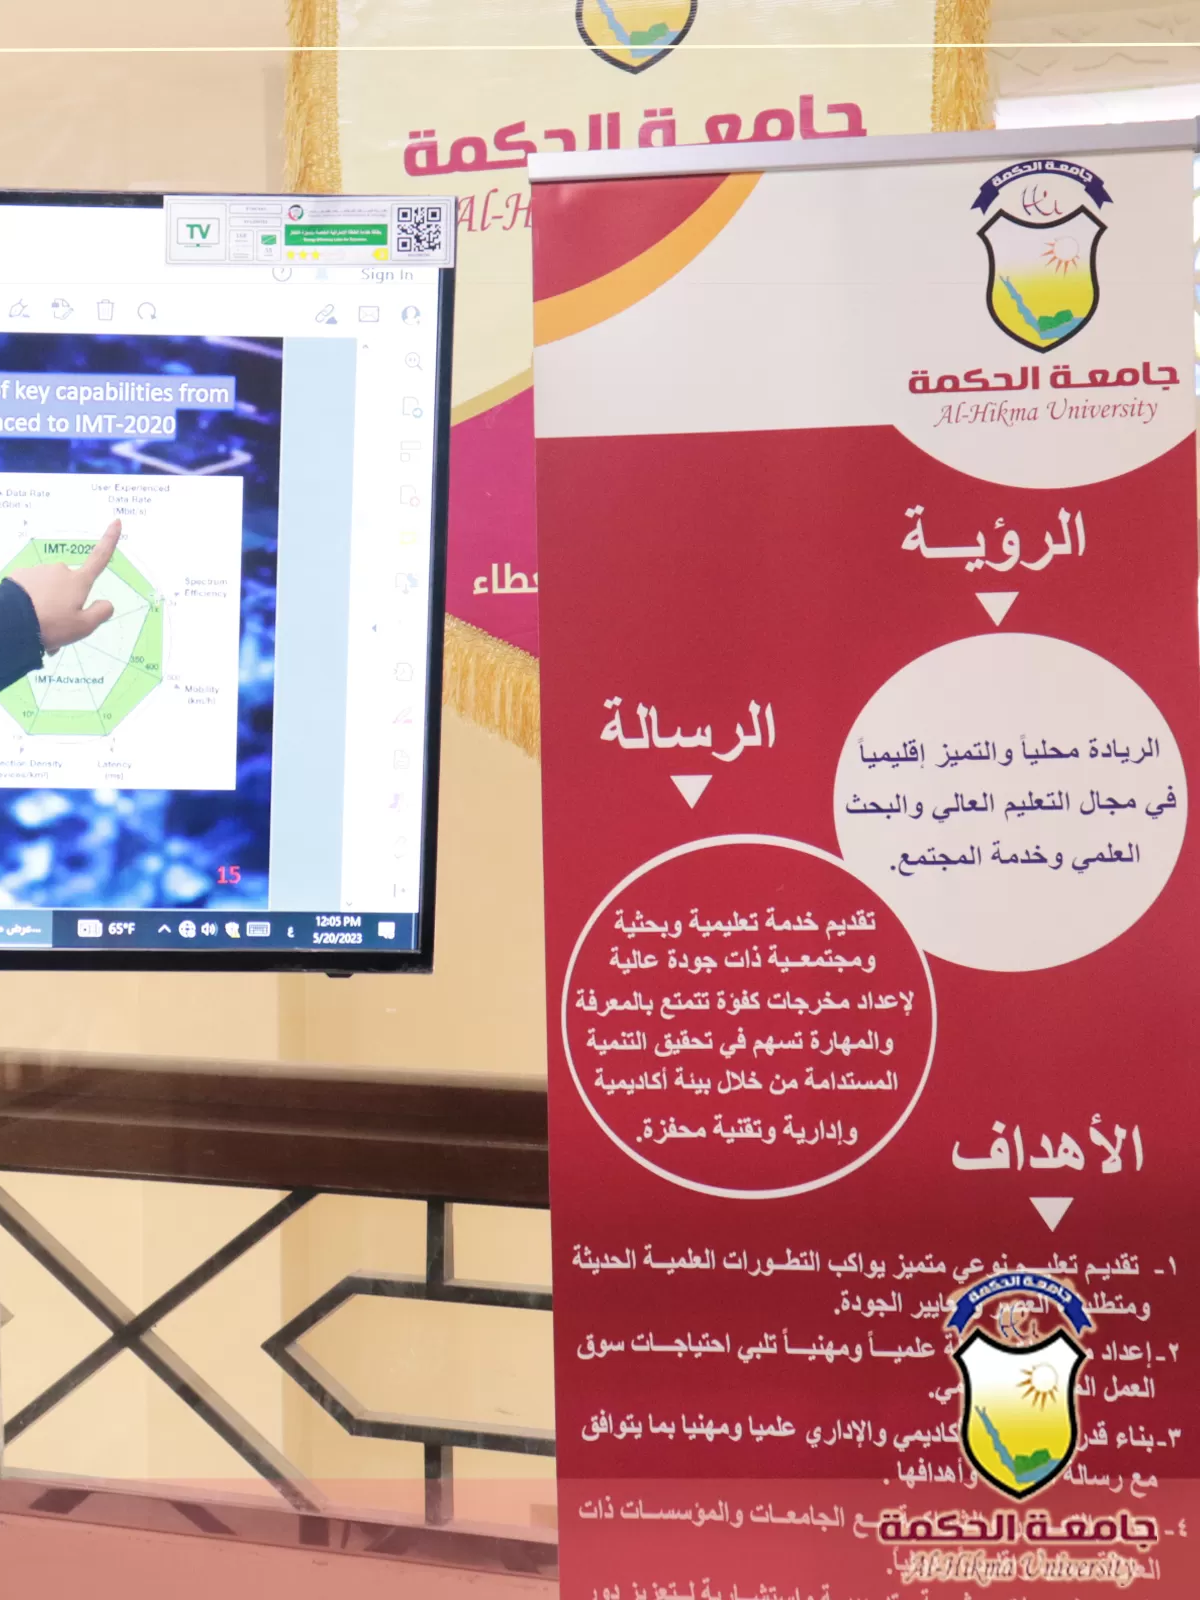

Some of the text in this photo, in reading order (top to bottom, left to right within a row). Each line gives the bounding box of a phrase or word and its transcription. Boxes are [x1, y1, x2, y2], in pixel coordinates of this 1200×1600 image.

[992, 162, 1042, 186] الحكمة
[186, 224, 211, 239] TV
[361, 268, 415, 283] Sign In
[908, 361, 1180, 394] جامعة الحكمة
[15, 380, 49, 405] key
[56, 381, 172, 406] capabilities
[178, 383, 229, 402] from
[47, 414, 69, 432] to
[76, 414, 175, 434] IMT-2020
[933, 400, 1158, 427] Al-Hikma University
[5, 488, 27, 498] Data
[29, 488, 51, 499] Rate
[107, 494, 153, 505] Data Rate
[114, 482, 171, 495] Experienced
[901, 504, 1085, 572] الرؤية
[184, 576, 229, 587] Spectrum
[184, 588, 228, 599] Efficiency
[34, 675, 105, 685] IMT-Advanced
[184, 684, 219, 696] Mobility
[600, 696, 776, 762] الرسالة
[934, 739, 1014, 769] والتميز
[1088, 737, 1161, 767] الريادة
[844, 784, 1177, 824] في مجال التعليم العالي والبحث
[889, 839, 1141, 877] العلمي وخدمة المجتمع.
[217, 866, 241, 884] 15
[108, 922, 135, 935] 65°F
[315, 915, 362, 928] 12:05 PM
[615, 907, 876, 940] تقديم خدمة تعليمية وبحثية
[312, 931, 363, 945] 5/20/2023
[609, 947, 658, 974] عالية
[668, 949, 717, 974] جودة
[724, 946, 761, 968] ذات
[576, 989, 653, 1016] بالمعرفة
[660, 992, 710, 1019] تتمتع
[767, 991, 850, 1015] مخرجات
[858, 991, 914, 1016] لإعداد
[587, 1027, 893, 1058] والمهارة تسهم في تحقيق التنمية
[595, 1067, 898, 1095] المستدامة من خلال بيئة أكاديمية
[636, 1114, 858, 1145] وإدارية وتقنية محفزة.
[952, 1113, 1144, 1174] الأهداف
[572, 1244, 636, 1275] الحديثة
[643, 1244, 715, 1275] العلمية
[723, 1248, 820, 1276] التطورات
[828, 1253, 885, 1279] يواكب
[893, 1254, 946, 1279] متميز
[1085, 1253, 1139, 1284] تقديم
[833, 1289, 903, 1318] الجودة.
[577, 1334, 624, 1359] سوق
[738, 1333, 777, 1363] تلبي
[1103, 1374, 1155, 1402] العمل
[582, 1410, 642, 1441] يتوافق
[649, 1414, 675, 1439] بما
[682, 1414, 742, 1441] ومهنيا
[749, 1416, 795, 1442] علميا
[806, 1420, 887, 1448] والإداري
[1130, 1472, 1158, 1498] مع
[579, 1496, 614, 1518] ذات
